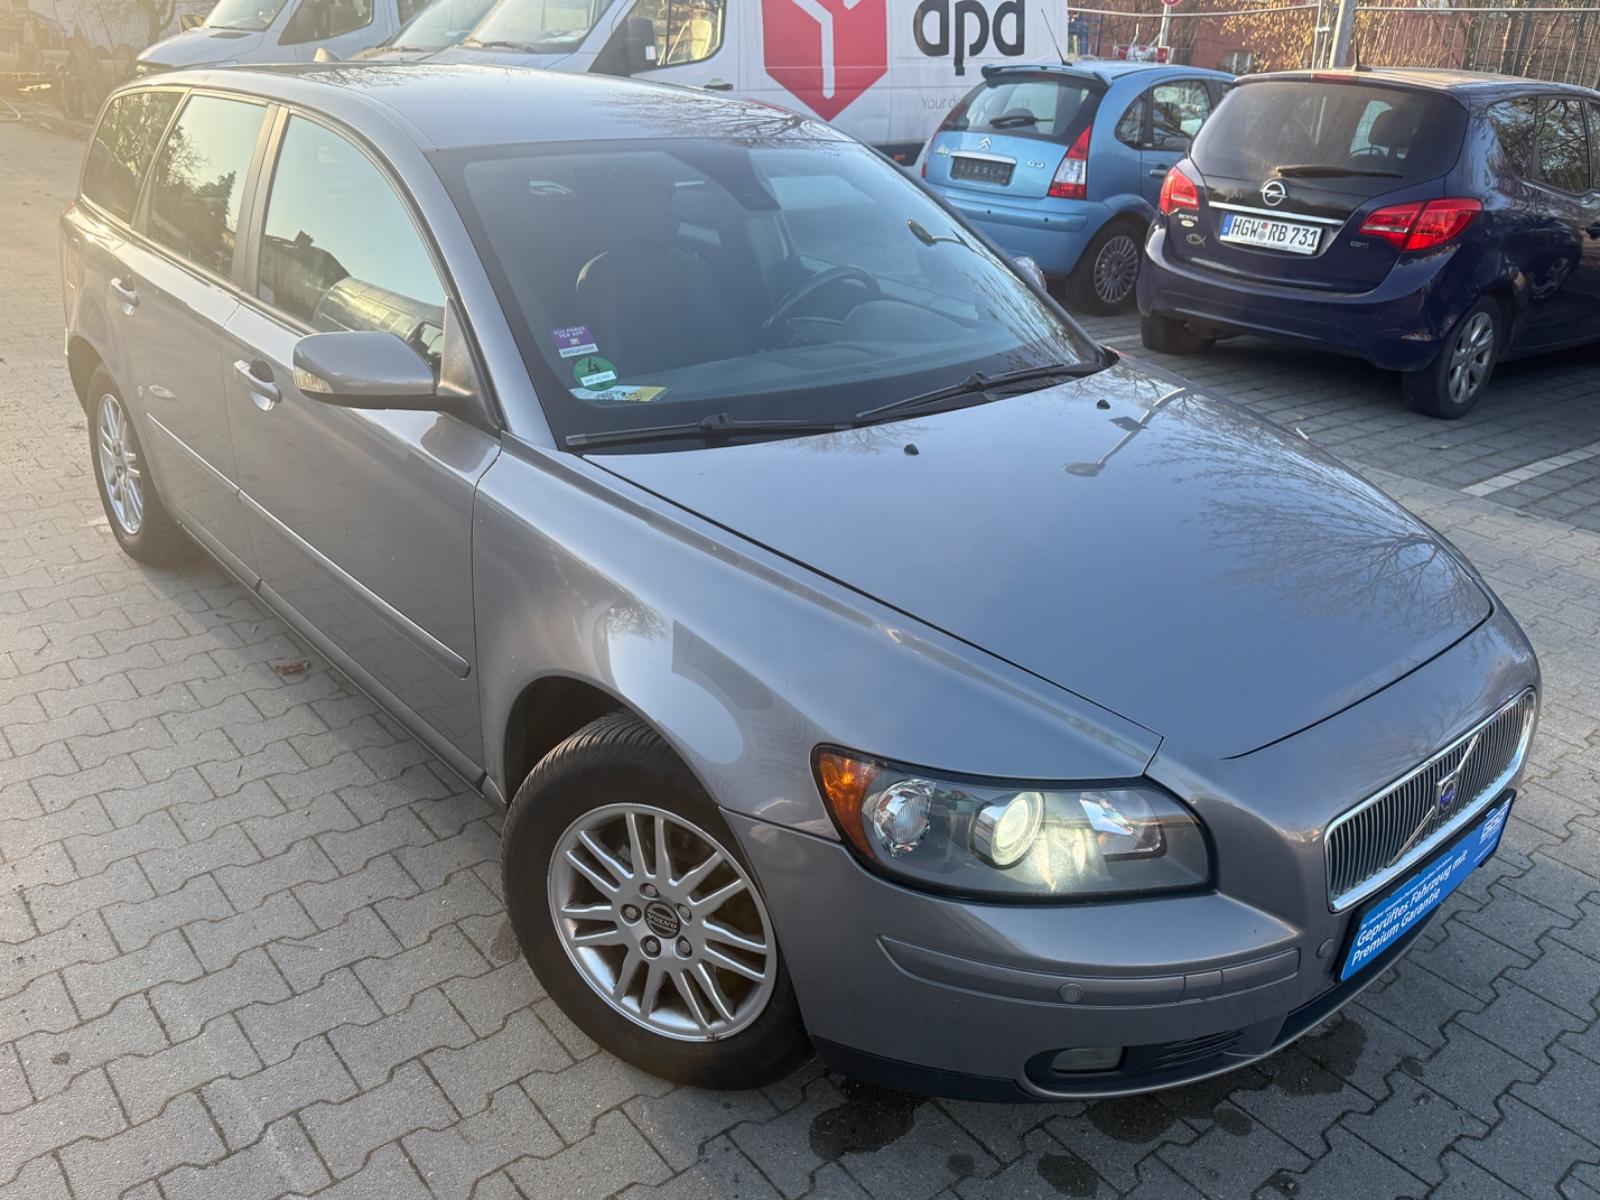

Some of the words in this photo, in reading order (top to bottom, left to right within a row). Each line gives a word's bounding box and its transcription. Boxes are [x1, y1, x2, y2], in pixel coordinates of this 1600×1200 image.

[913, 0, 1025, 76] dpd
[921, 96, 946, 110] Your
[1231, 217, 1260, 238] HGW
[1268, 223, 1288, 242] RB
[1289, 227, 1318, 247] 731
[1351, 923, 1399, 966] Premium
[1401, 888, 1441, 927] Garantie
[1357, 901, 1409, 946] Geprüftes
[1410, 865, 1452, 907] Fahrzeug
[1452, 849, 1468, 871] mit
